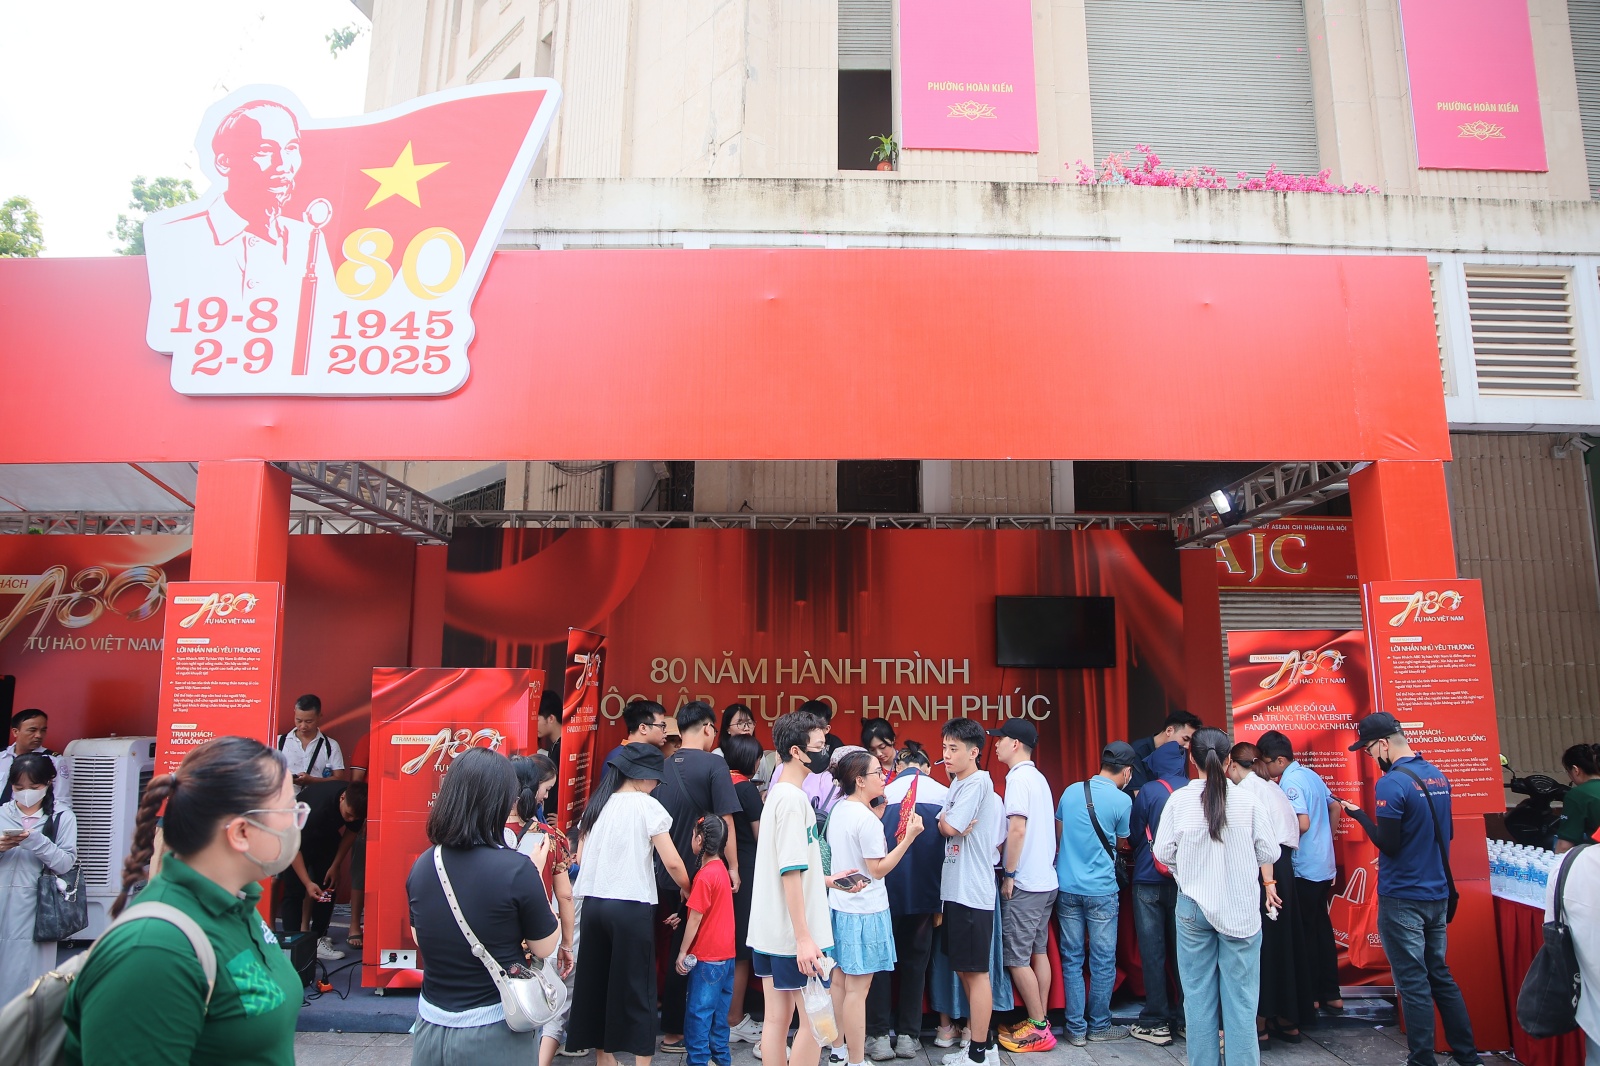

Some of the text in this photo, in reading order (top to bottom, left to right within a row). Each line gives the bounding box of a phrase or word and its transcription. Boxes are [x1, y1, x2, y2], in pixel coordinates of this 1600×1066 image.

[928, 81, 1013, 92] PHƯỜNG HOÀN KIẾM
[1437, 101, 1519, 112] PHƯỜNG HOÀN KIẾM
[335, 226, 465, 301] 80
[170, 296, 278, 333] 19-8
[330, 309, 454, 340] 1945
[190, 337, 274, 376] 2-9
[327, 344, 450, 375] 2025
[1216, 533, 1308, 582] AJC
[0, 577, 28, 588] HÁCH
[28, 634, 164, 653] TỰ HÀO VIỆT NAM
[650, 650, 970, 684] 80 NĂM HÀNH TRÌNH
[863, 696, 953, 727] HẠNH
[962, 688, 1051, 721] PHÚC
[1252, 713, 1264, 721] ĐÃ
[1265, 713, 1293, 721] TRÚNG
[1296, 712, 1316, 721] TRÊN
[1286, 705, 1302, 713] VỰC
[1304, 702, 1318, 712] ĐỔI
[1320, 703, 1336, 712] QUÀ
